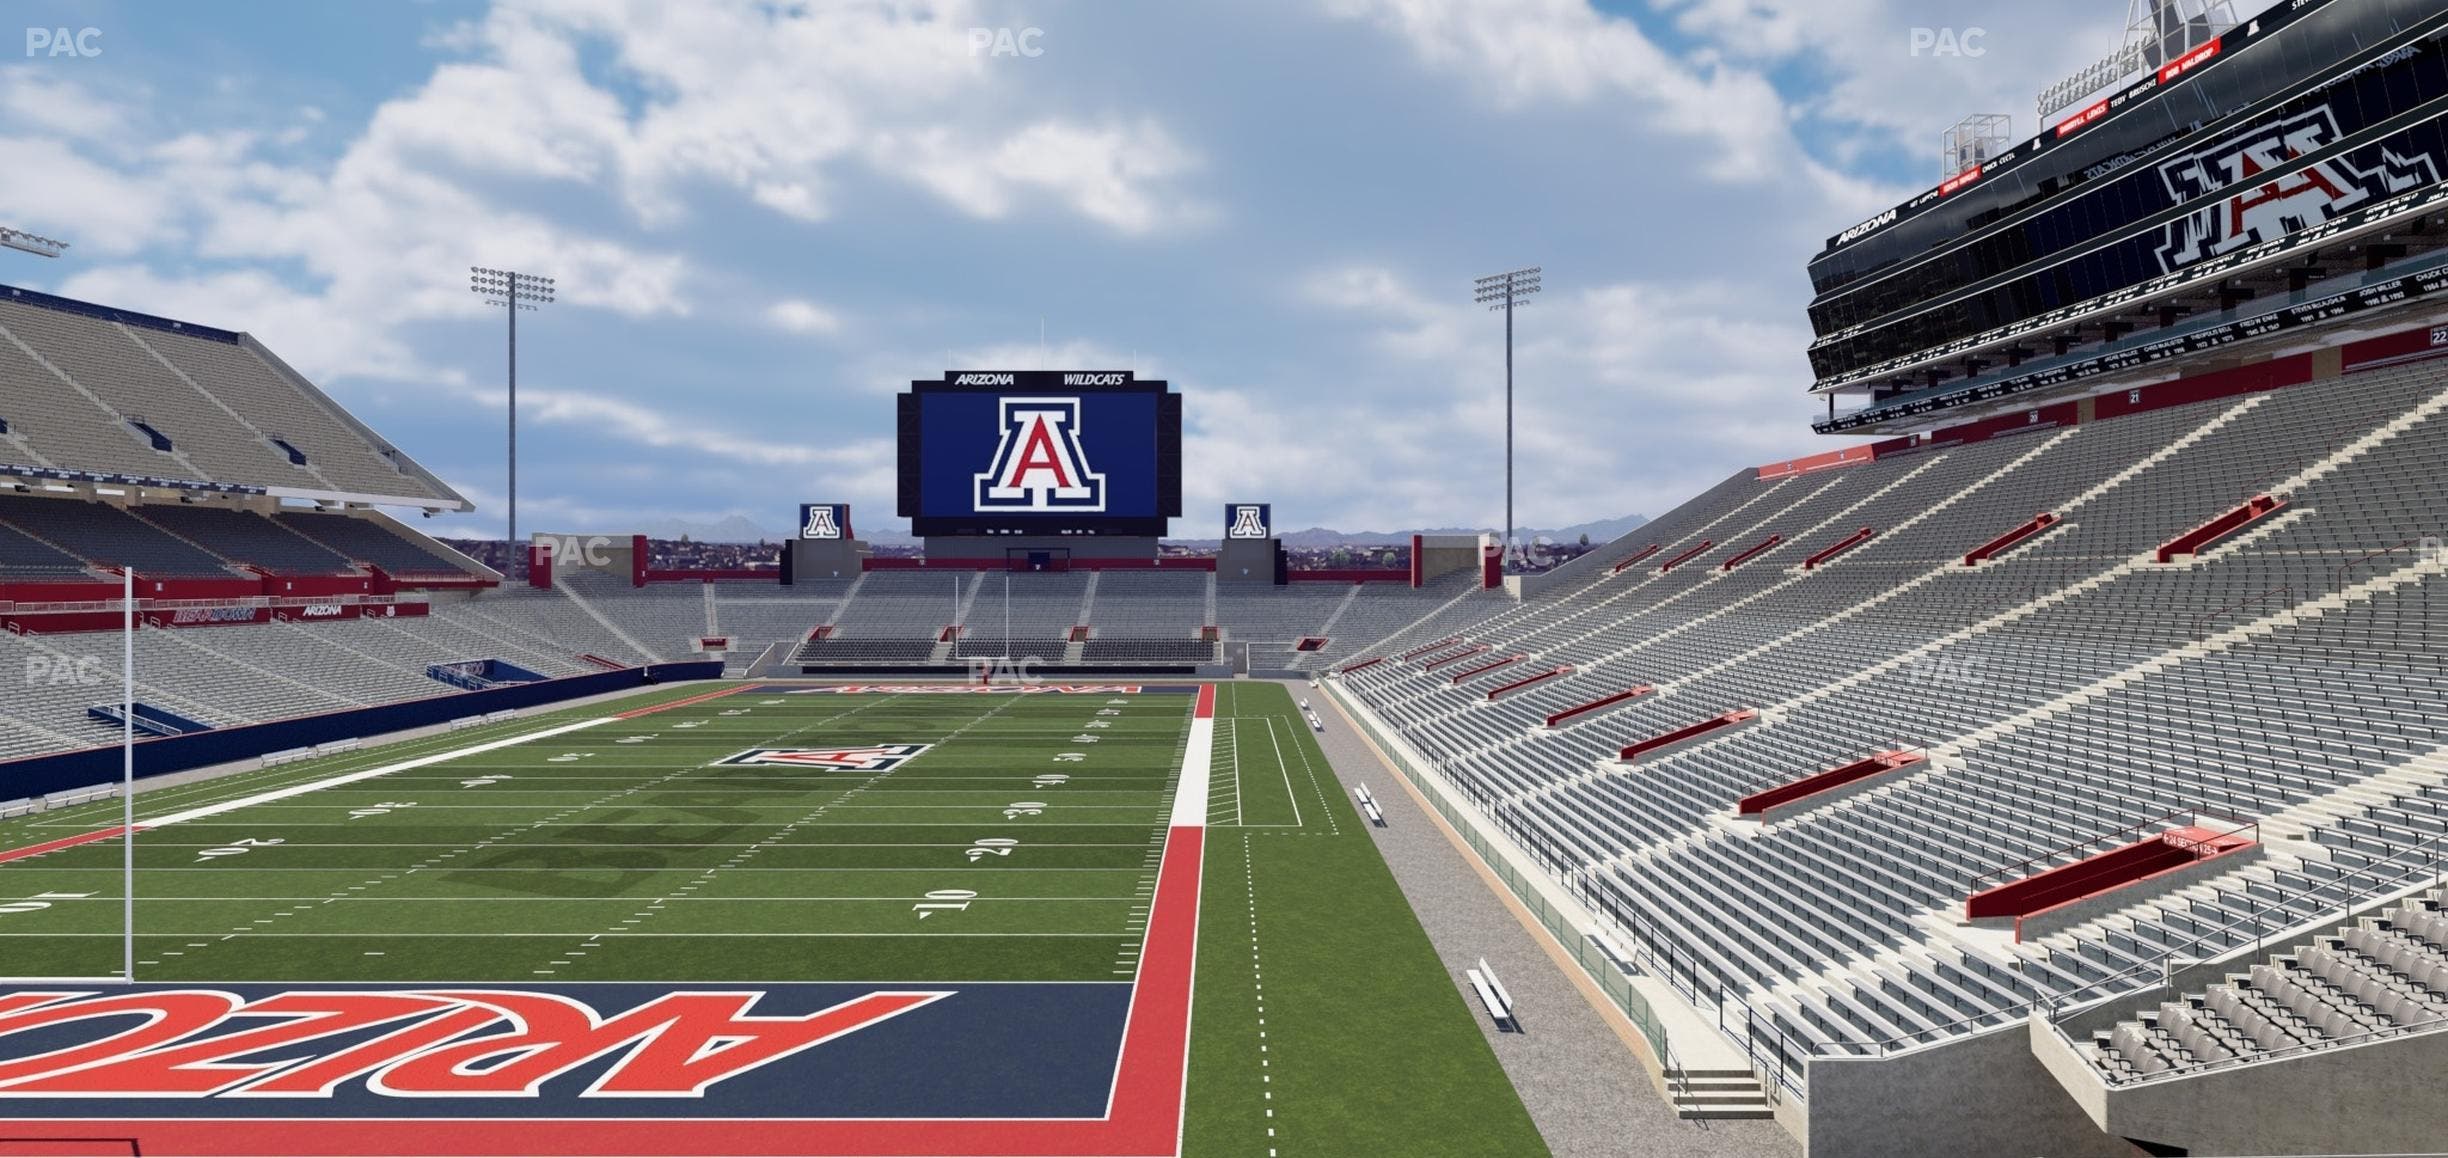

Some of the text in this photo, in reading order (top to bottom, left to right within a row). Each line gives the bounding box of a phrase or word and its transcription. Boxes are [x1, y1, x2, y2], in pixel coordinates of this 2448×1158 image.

[1835, 209, 1897, 246] ARIZONA
[2433, 331, 2447, 344] 22
[955, 374, 1014, 385] ARIZONA
[1064, 374, 1125, 385] WILDCATS
[2130, 391, 2141, 403] 21
[974, 397, 1106, 512] A
[803, 506, 841, 539] A
[1229, 506, 1267, 539] A
[303, 605, 342, 616] ARIZONA
[965, 838, 1019, 856] 20
[912, 889, 978, 912] 10
[0, 990, 958, 1099] ARIZO
